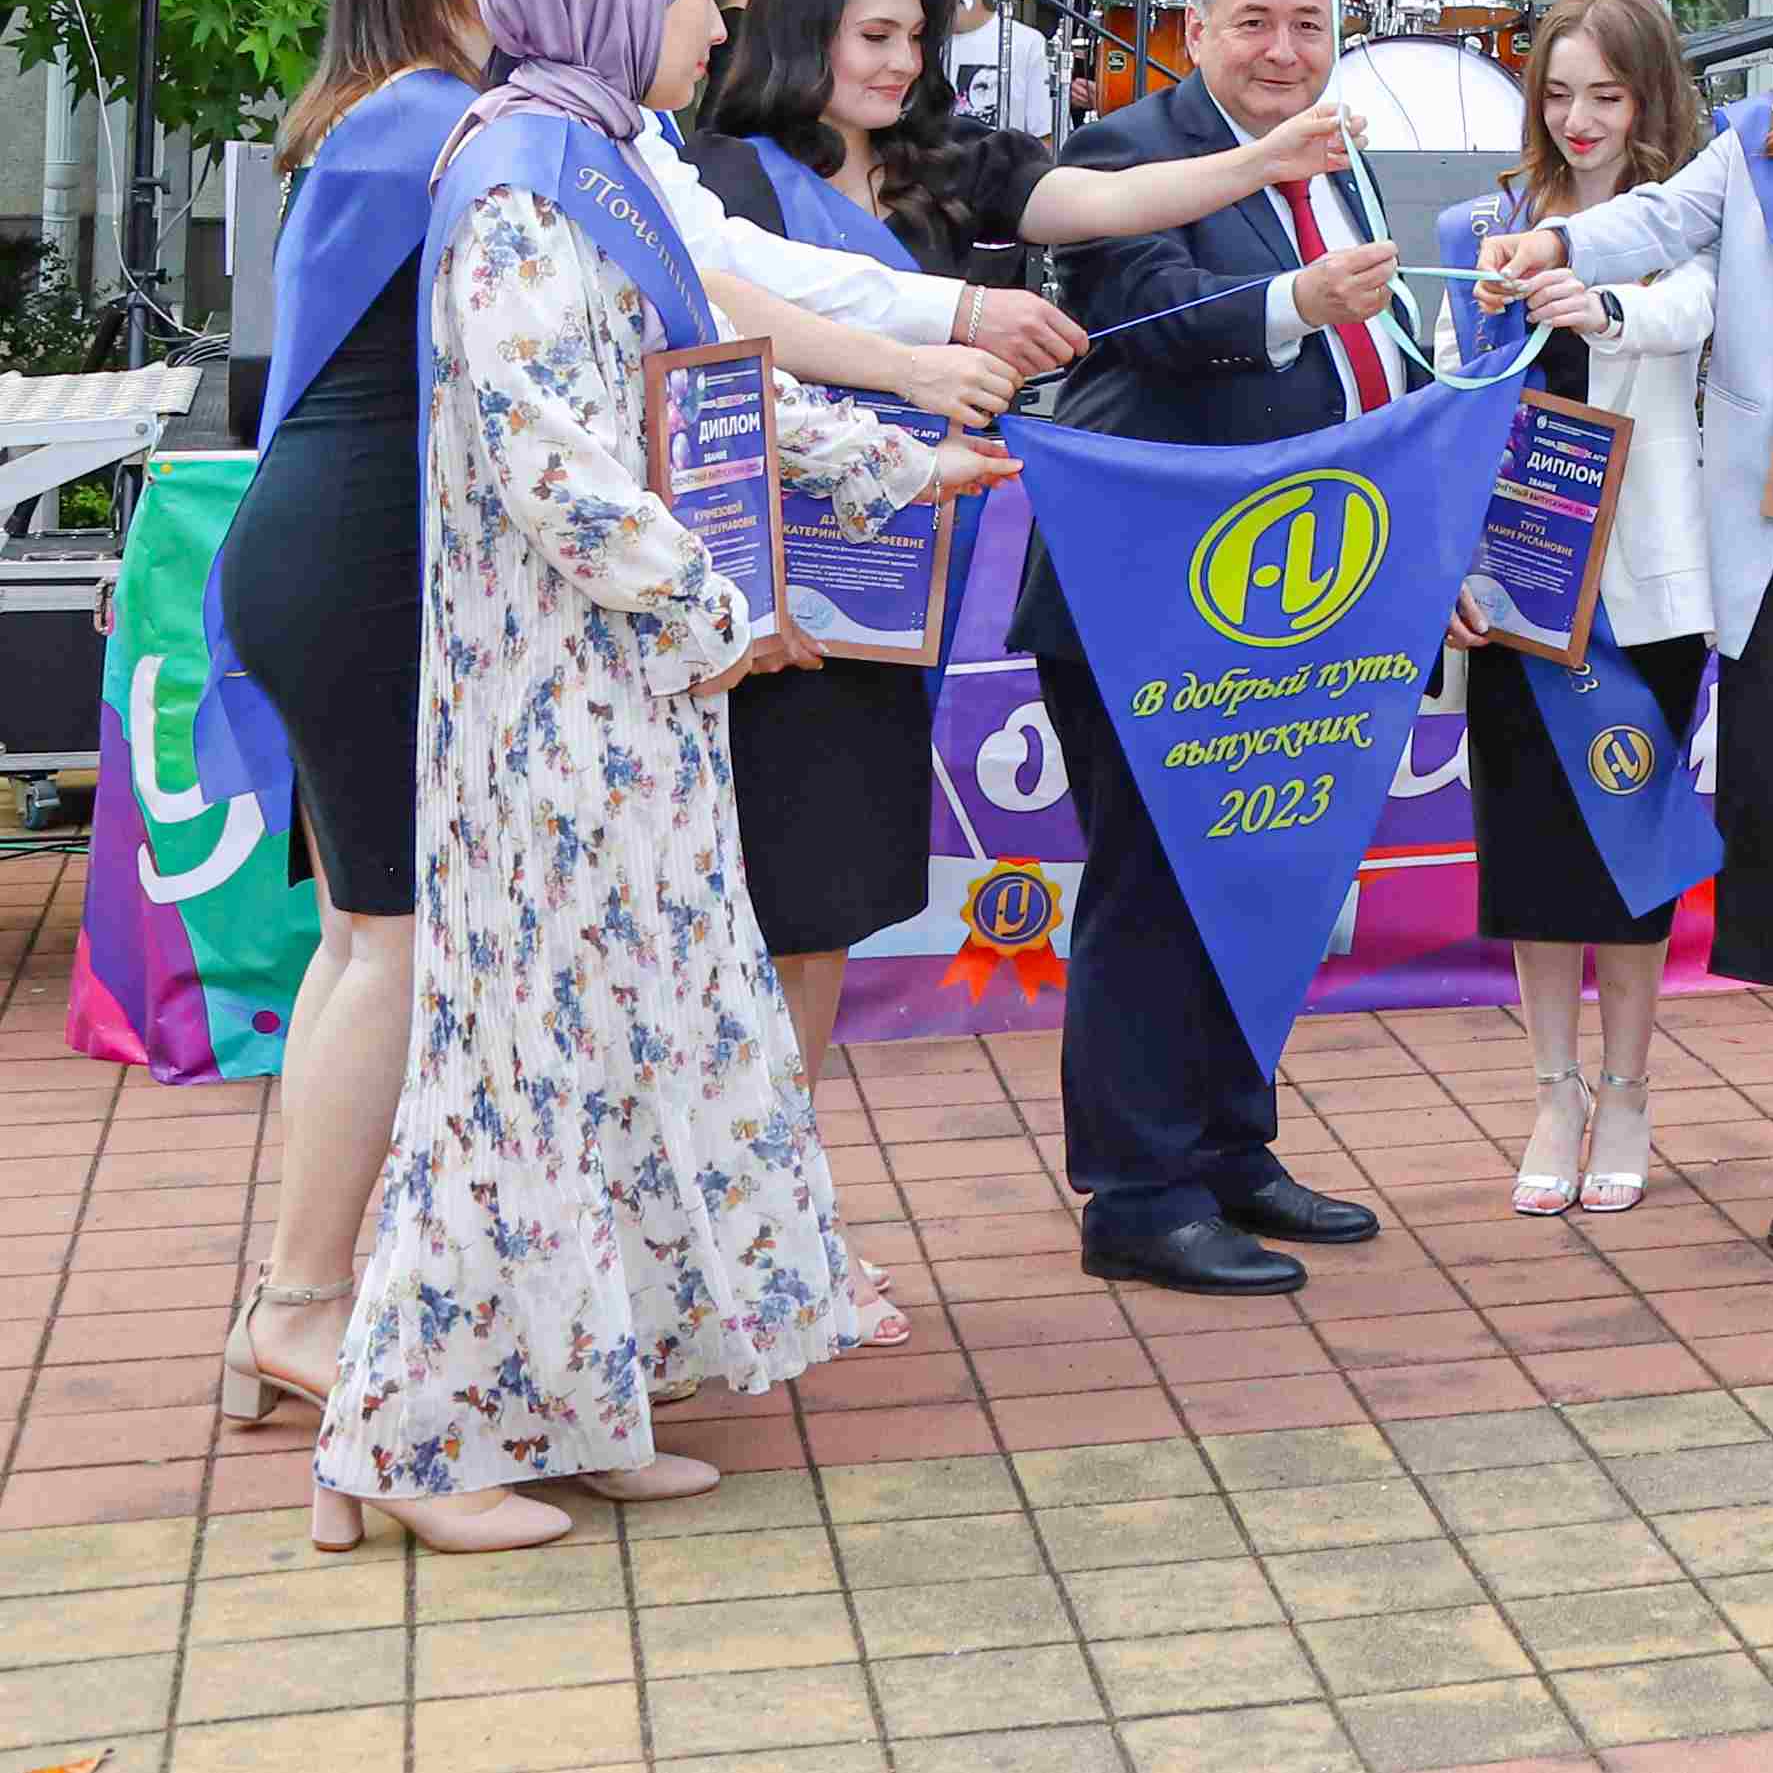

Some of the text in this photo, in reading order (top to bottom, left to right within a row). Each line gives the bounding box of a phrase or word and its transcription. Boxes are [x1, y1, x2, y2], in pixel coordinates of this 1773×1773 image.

[698, 411, 760, 444] ДИПЛОМ
[1526, 451, 1604, 487] ДИПЛОМ
[784, 525, 848, 541] КАТЕРИНЕ
[1131, 651, 1420, 718] В добрый путь,
[1163, 710, 1374, 773] выпускник
[1206, 773, 1335, 839] 2023
